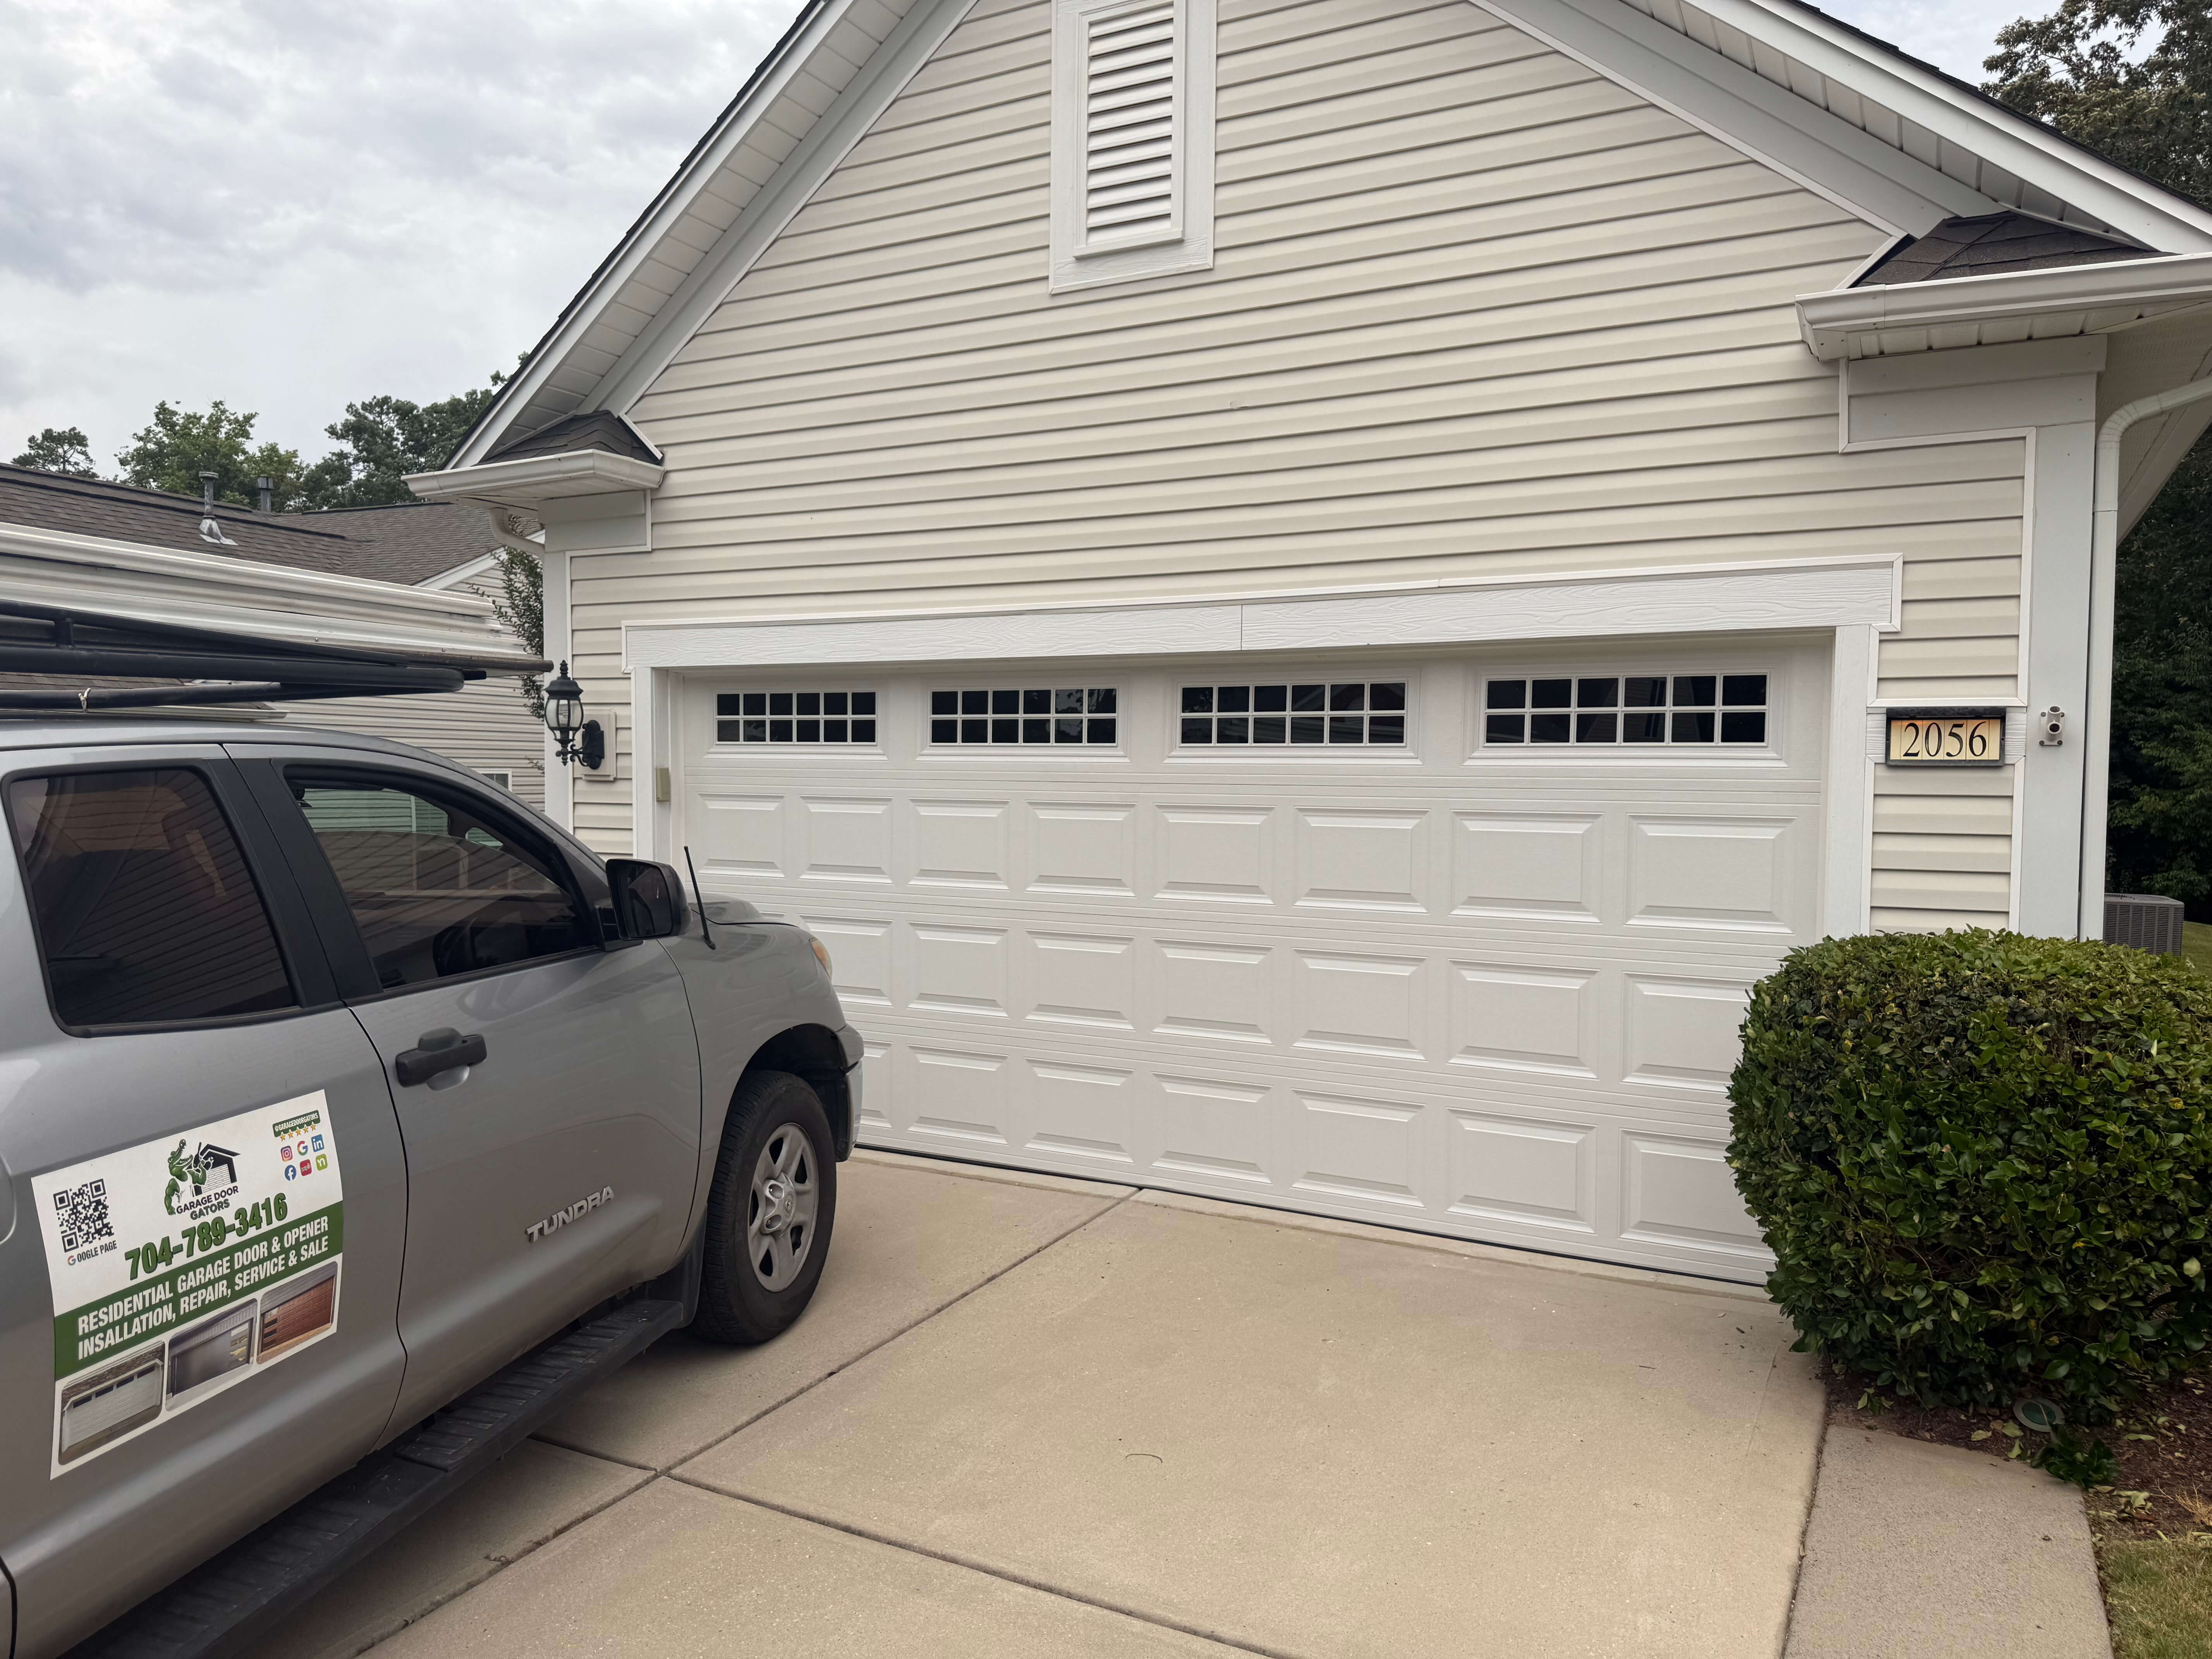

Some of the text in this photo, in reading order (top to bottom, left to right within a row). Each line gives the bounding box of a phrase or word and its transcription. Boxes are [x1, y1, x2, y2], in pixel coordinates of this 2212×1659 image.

[1903, 721, 1987, 757] 2056
[275, 1113, 318, 1132] @GARAGEDOORGATORS
[176, 1186, 239, 1214] GARAGE DOOR
[190, 1199, 230, 1220] GATORS
[526, 1185, 615, 1243] TUNDRA
[100, 1240, 117, 1254] PAGE
[125, 1193, 288, 1280] 704-789-3416
[78, 1216, 328, 1336] RESIDENTIAL GARAGE DOOR & OPENER
[79, 1235, 328, 1360] INSALLATION, REPAIR, SERVICE & SALE
